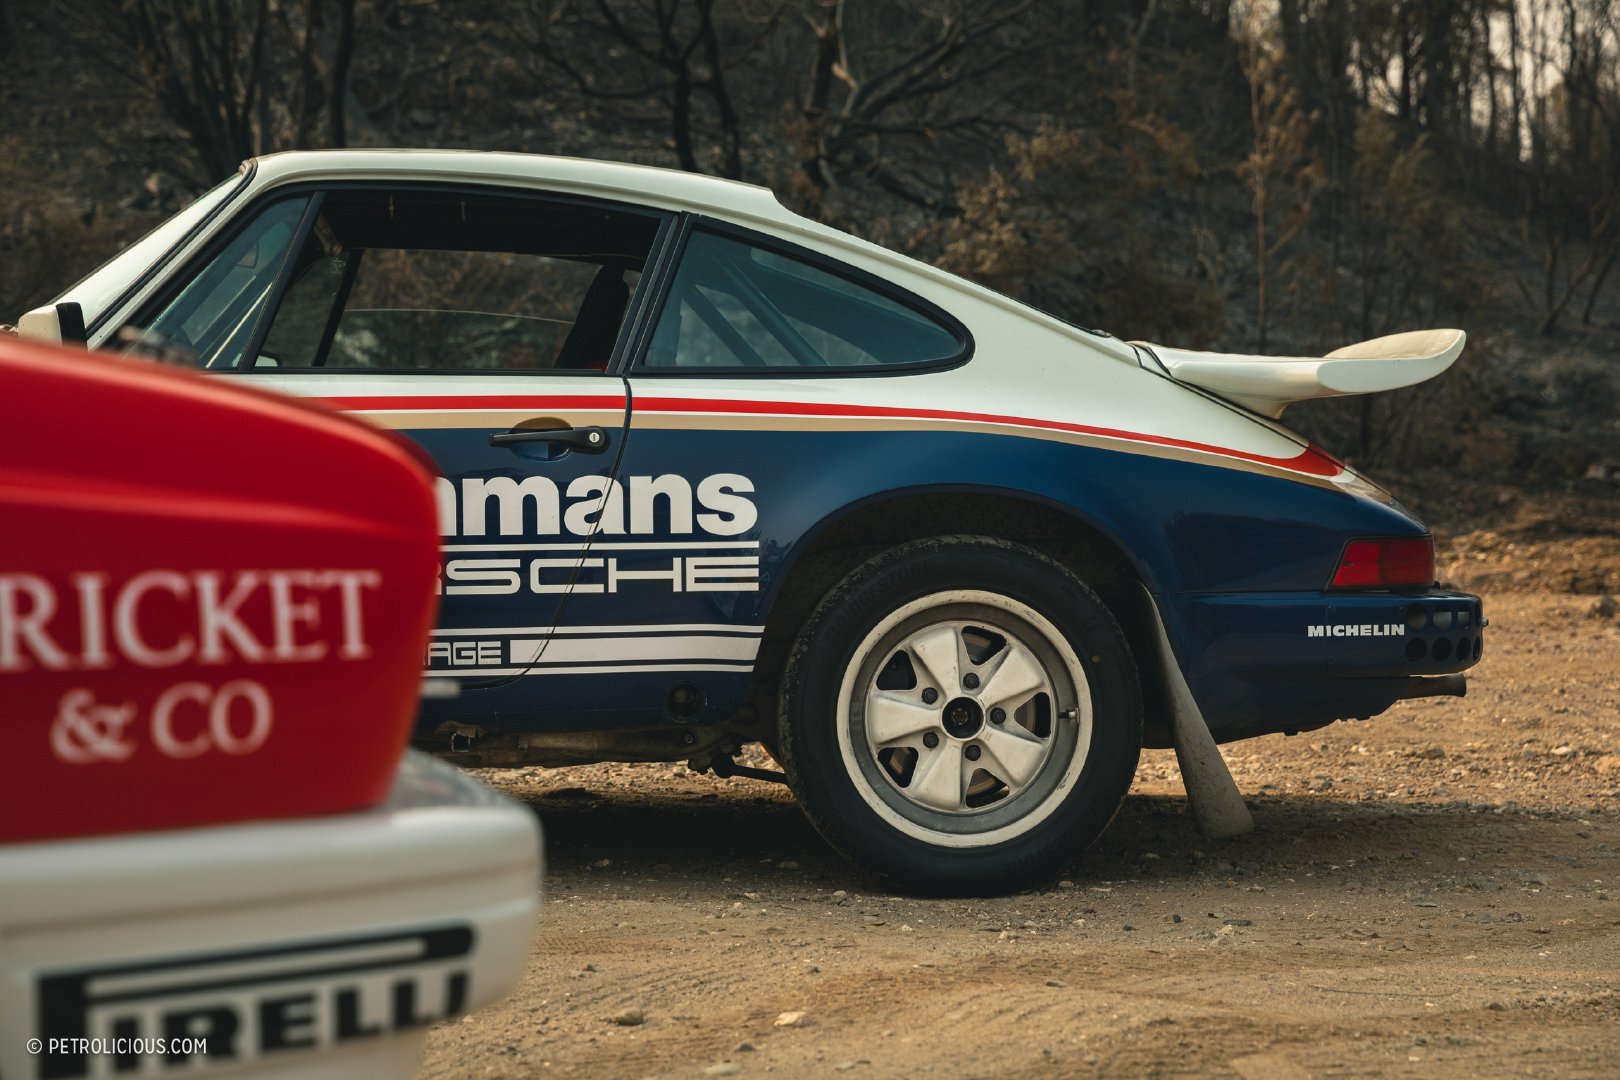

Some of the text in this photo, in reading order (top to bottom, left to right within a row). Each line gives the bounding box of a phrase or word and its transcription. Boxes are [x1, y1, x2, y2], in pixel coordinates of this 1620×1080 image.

[434, 556, 760, 595] SCHE
[1307, 623, 1405, 637] MICHELIN
[424, 641, 502, 666] AGE
[50, 680, 273, 764] & CO
[36, 920, 476, 1080] PIRELLI
